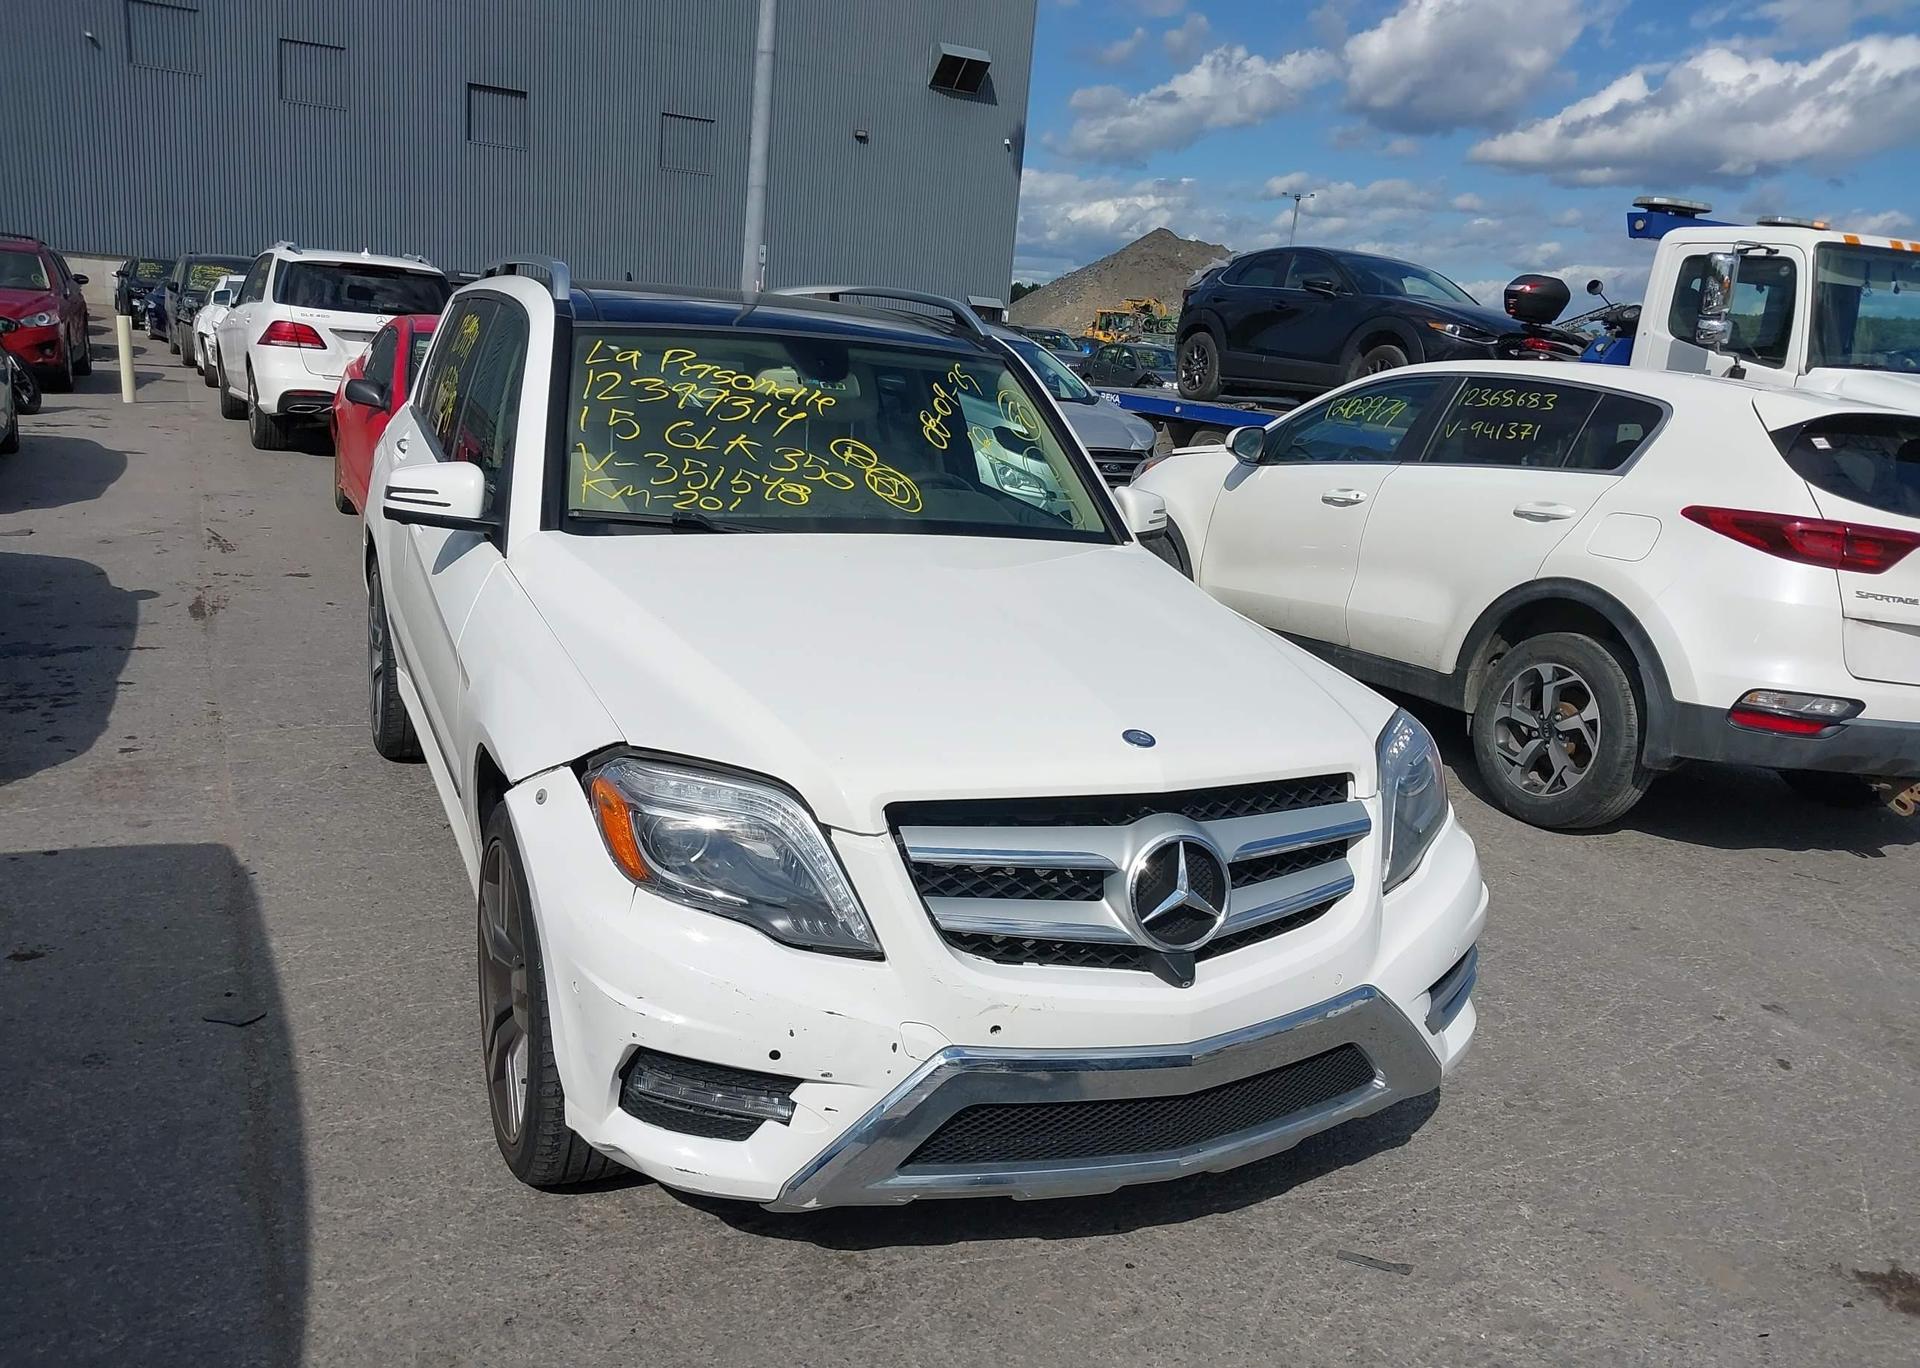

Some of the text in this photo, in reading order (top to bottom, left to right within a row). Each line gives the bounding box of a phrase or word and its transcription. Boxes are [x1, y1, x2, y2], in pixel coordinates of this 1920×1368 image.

[585, 340, 642, 370] La
[583, 368, 807, 437] 12399314
[1458, 387, 1558, 411] 12368683
[1446, 421, 1541, 441] V-941371
[580, 405, 641, 440] 15
[664, 420, 763, 463] GLK
[769, 447, 855, 490] 350
[1855, 590, 1919, 606] SPORTAGE
